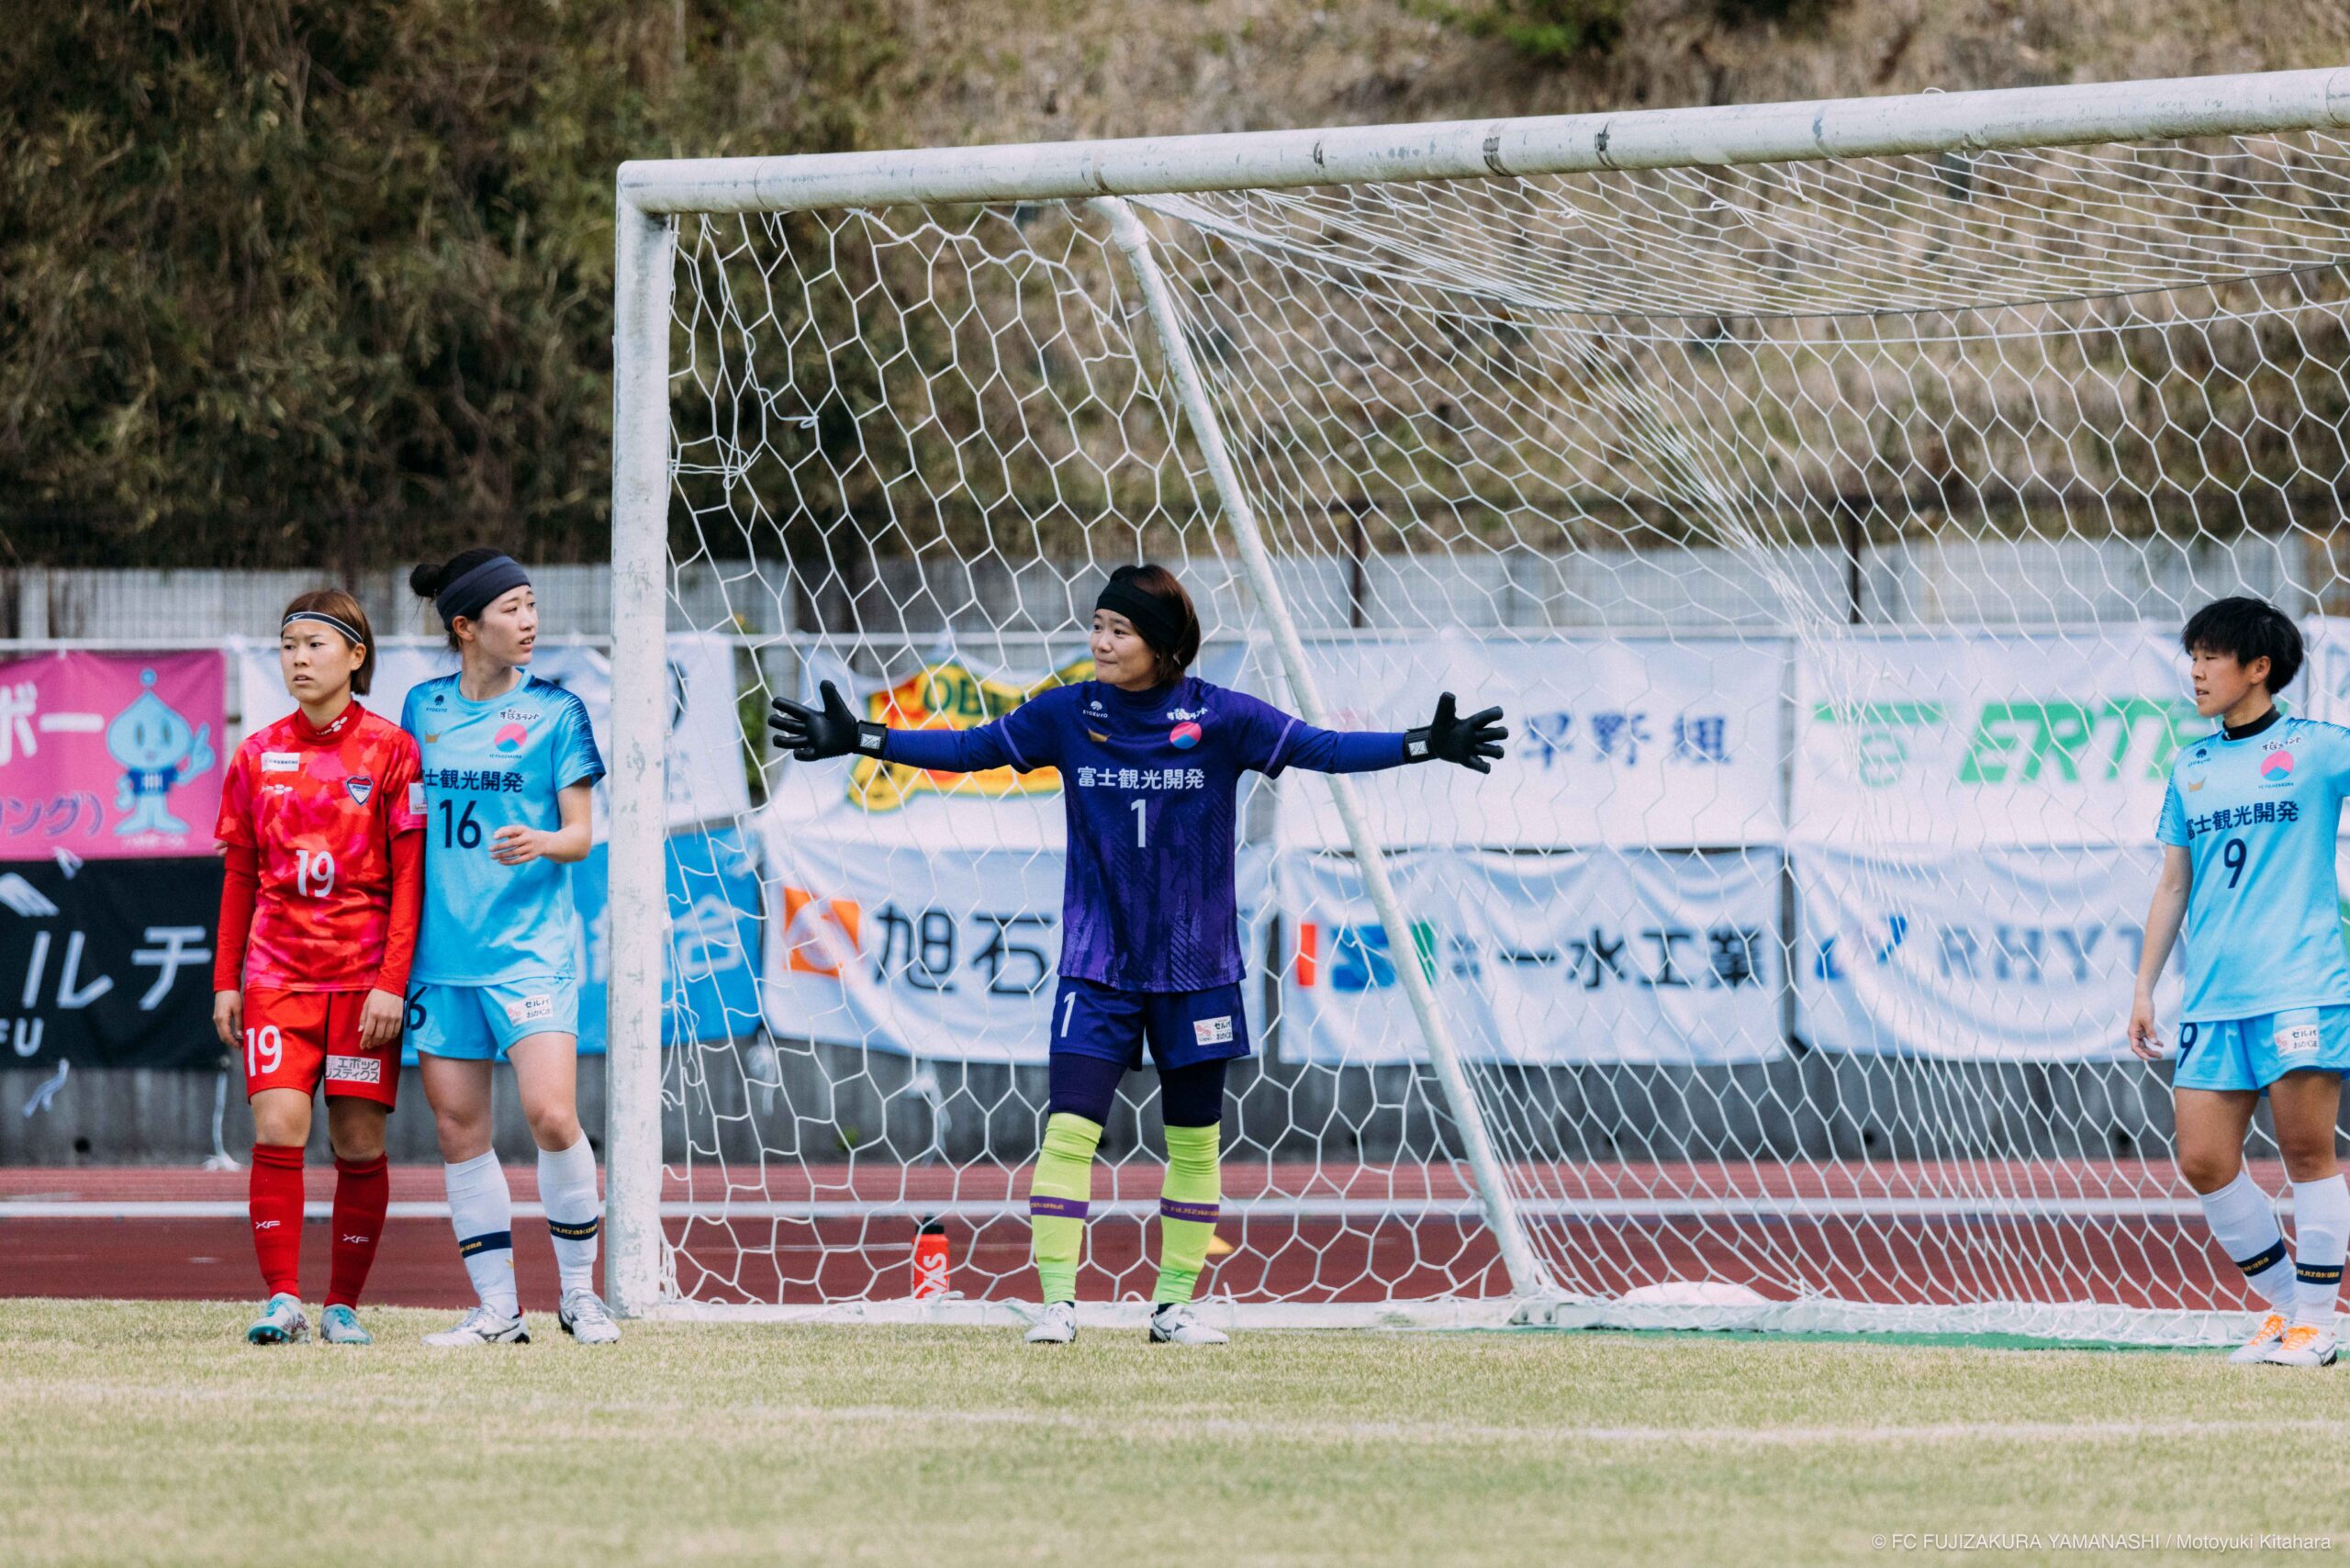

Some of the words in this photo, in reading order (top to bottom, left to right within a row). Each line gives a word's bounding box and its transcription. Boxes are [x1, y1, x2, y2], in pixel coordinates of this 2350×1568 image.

[421, 768, 524, 792] 士観光開発
[1078, 766, 1204, 790] 富士観光開発
[0, 792, 103, 836] ング)
[439, 799, 482, 849] 16
[1130, 799, 1147, 847] 1
[2186, 801, 2299, 840] 富士観光開発
[296, 849, 335, 898] 19
[2223, 838, 2247, 889] 9
[22, 925, 213, 1011] ルチ
[1937, 924, 2187, 982] RHYT
[1059, 991, 1077, 1038] 1
[246, 1025, 282, 1077] 19
[338, 1057, 380, 1071] エポック
[2177, 1023, 2198, 1069] 9
